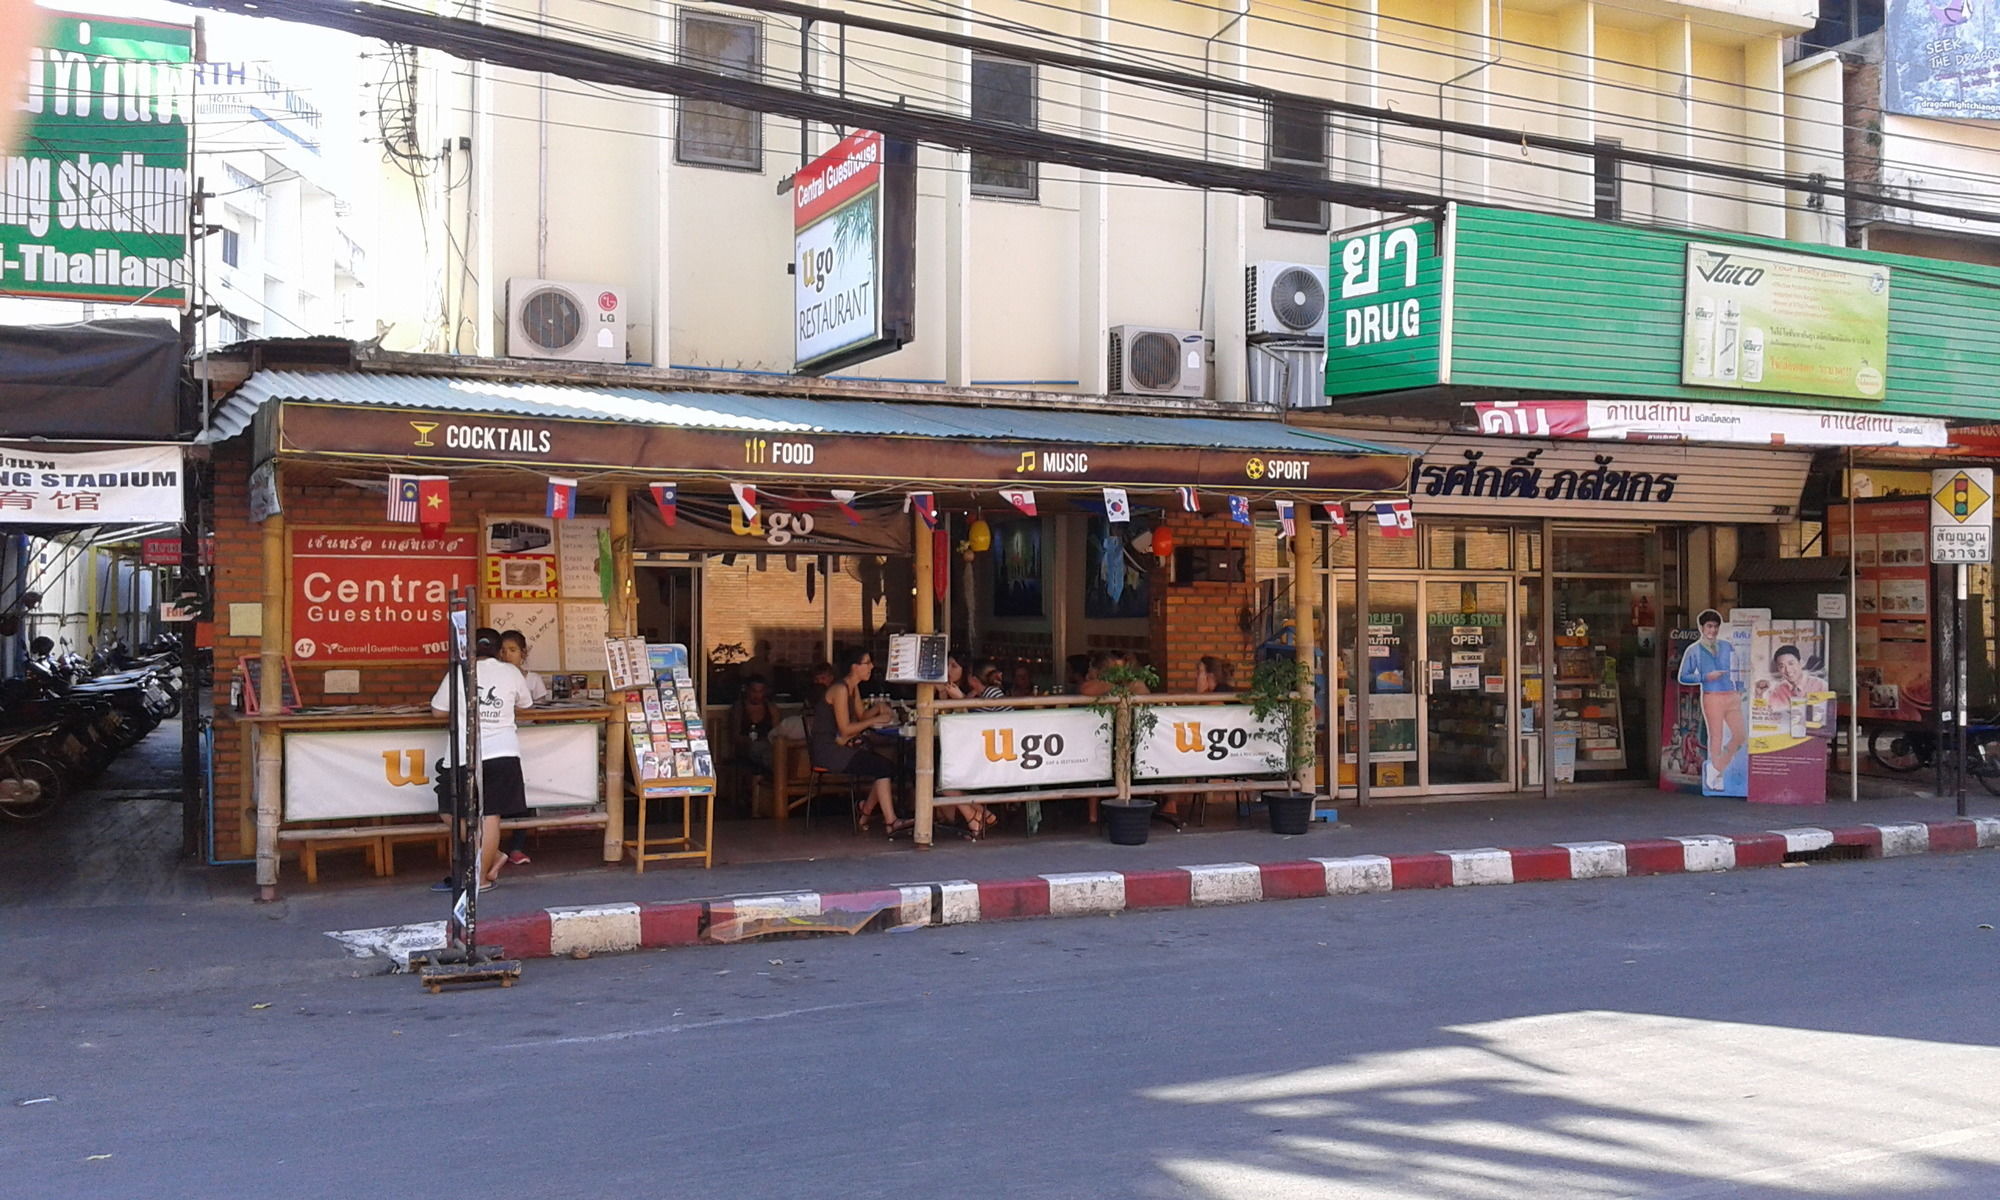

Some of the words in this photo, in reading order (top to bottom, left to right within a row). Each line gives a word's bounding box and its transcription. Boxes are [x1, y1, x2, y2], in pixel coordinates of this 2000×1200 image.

[1926, 38, 1961, 54] SEEK
[1929, 55, 1951, 68] THE
[798, 174, 825, 208] Central
[826, 142, 877, 190] Guesthouse
[1342, 227, 1418, 298] ยา
[600, 313, 615, 322] LG
[800, 281, 870, 341] RESTAURANT
[1346, 298, 1420, 346] DRUG
[446, 425, 550, 452] COCKTAILS
[772, 442, 814, 464] FOOD
[1043, 452, 1088, 473] MUSIC
[41, 471, 177, 487] STADIUM
[1268, 460, 1310, 480] SPORT
[303, 571, 459, 603] Central
[1429, 613, 1466, 625] DRUGS
[1470, 613, 1503, 625] STORE
[297, 642, 313, 652] 47
[1451, 635, 1484, 646] OPEN
[480, 710, 501, 718] ntral
[981, 727, 1065, 770] ugo
[1173, 721, 1248, 761] ugo
